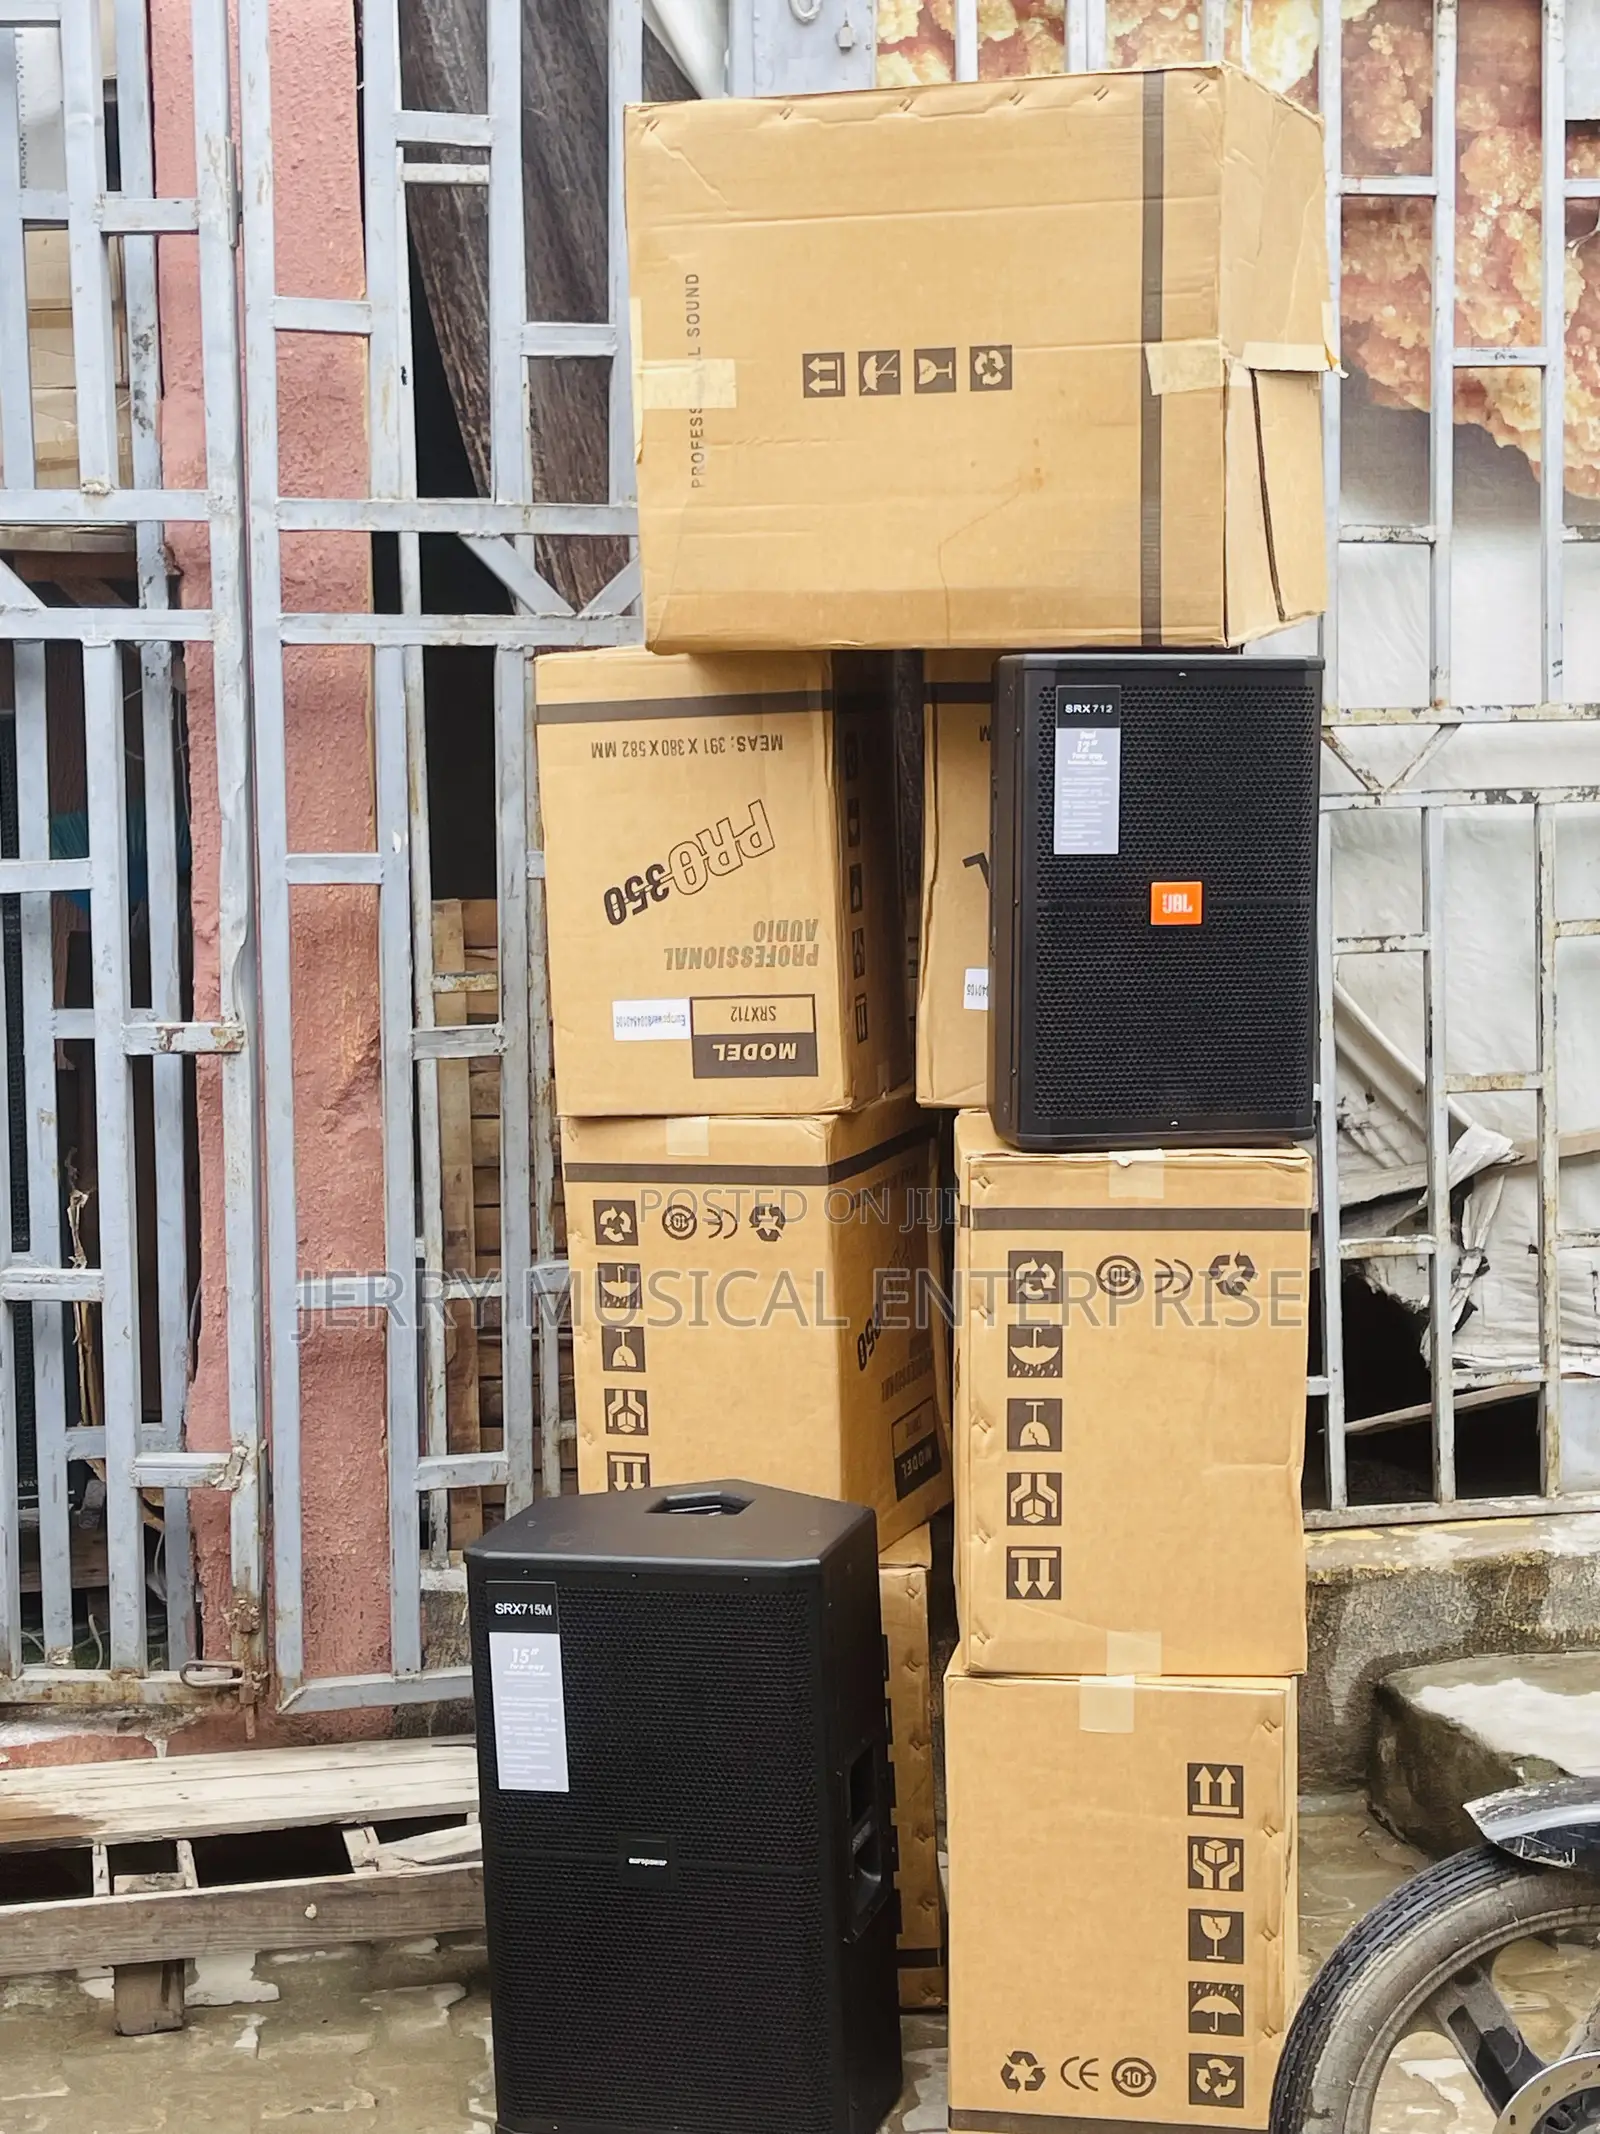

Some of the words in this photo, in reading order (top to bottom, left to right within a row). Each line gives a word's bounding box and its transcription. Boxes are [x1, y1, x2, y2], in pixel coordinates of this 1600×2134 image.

[686, 273, 701, 338] SOUND
[688, 346, 703, 488] PROFESSL
[590, 741, 618, 759] MM
[622, 740, 648, 758] 582
[649, 738, 661, 757] X
[661, 738, 686, 757] 380
[688, 737, 699, 755] X
[701, 736, 727, 754] 391
[732, 734, 783, 753] MEAS:
[1161, 893, 1194, 914] JBL
[753, 918, 819, 943] AUDIO
[663, 943, 819, 972] PROFESSIONAL
[729, 1004, 777, 1023] SRX712
[711, 1041, 797, 1062] MODEL
[494, 1602, 553, 1616] SRX715M
